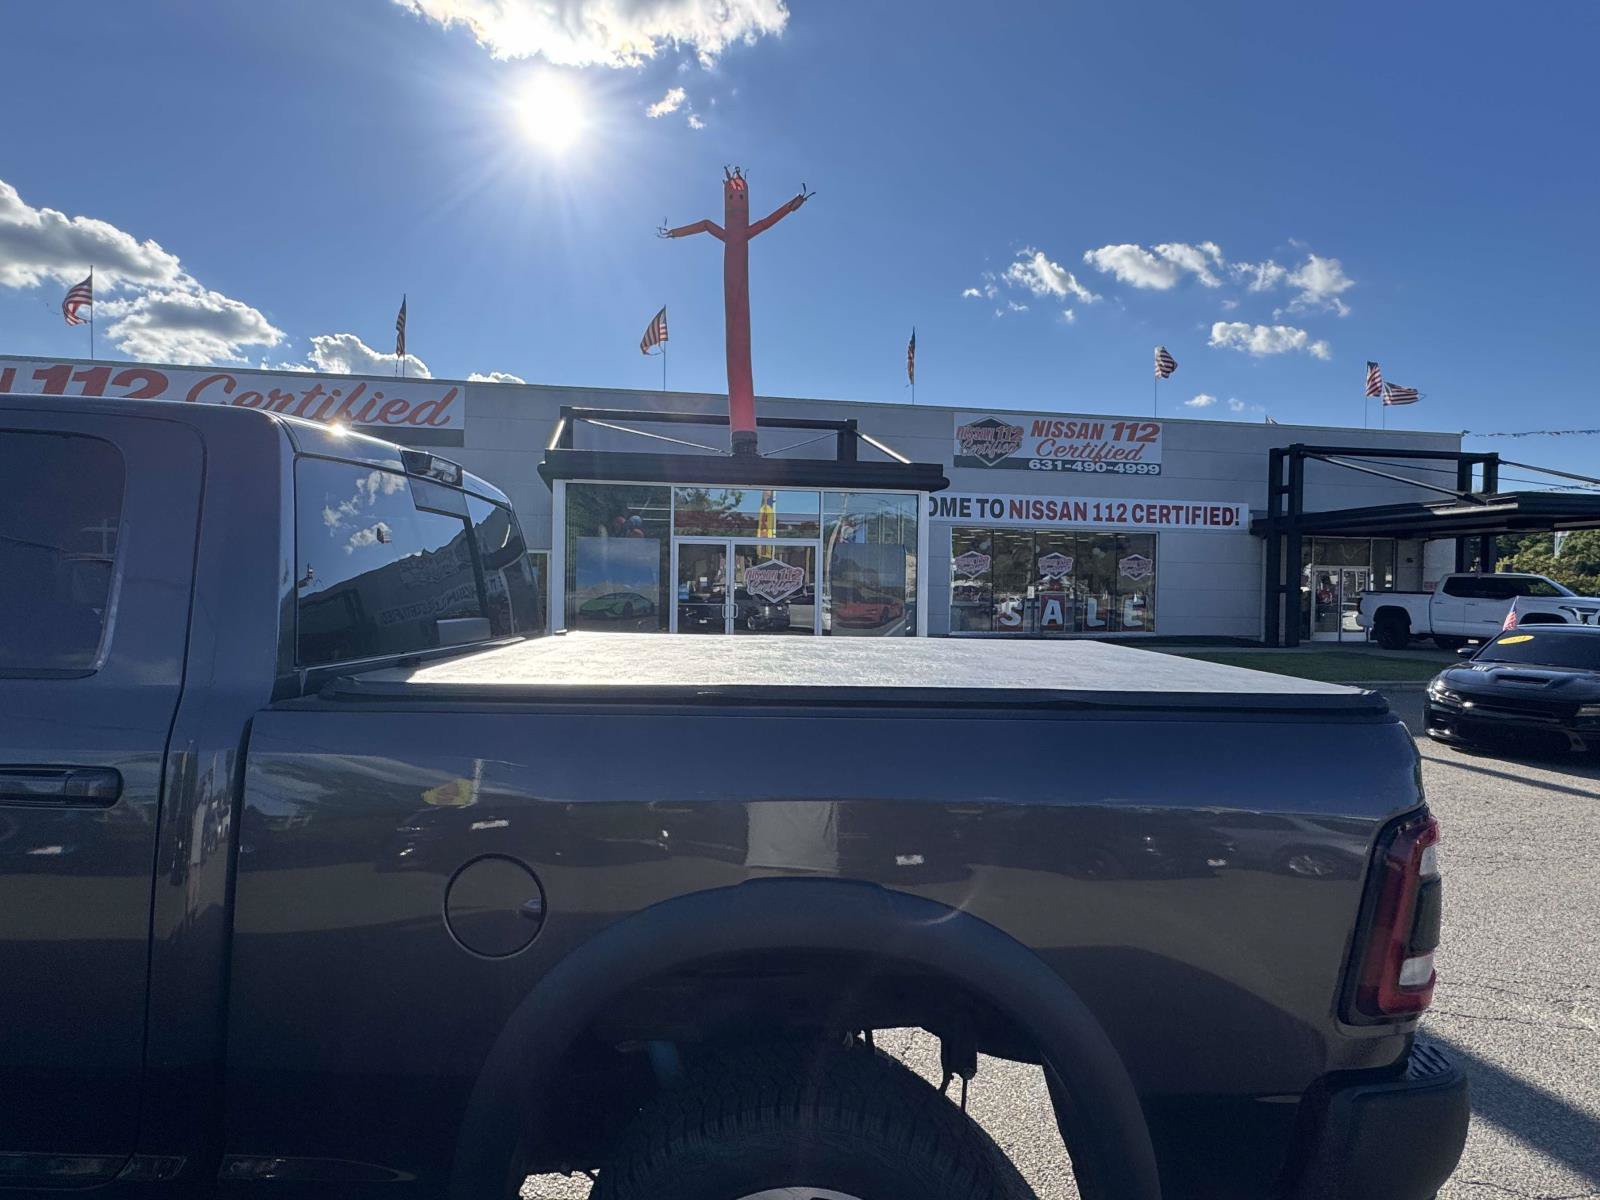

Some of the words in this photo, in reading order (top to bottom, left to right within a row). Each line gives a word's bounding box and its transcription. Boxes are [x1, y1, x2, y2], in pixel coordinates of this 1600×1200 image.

[32, 364, 169, 400] 112
[185, 374, 459, 427] Certified
[1030, 419, 1105, 440] NISSAN
[1111, 421, 1161, 443] 112
[1035, 439, 1146, 463] Certified
[1028, 459, 1160, 475] 631-490-4999
[976, 498, 1005, 519] TO
[1009, 499, 1088, 521] NISSAN
[1092, 502, 1128, 523] 112
[1131, 503, 1240, 526] CERTIFIED!
